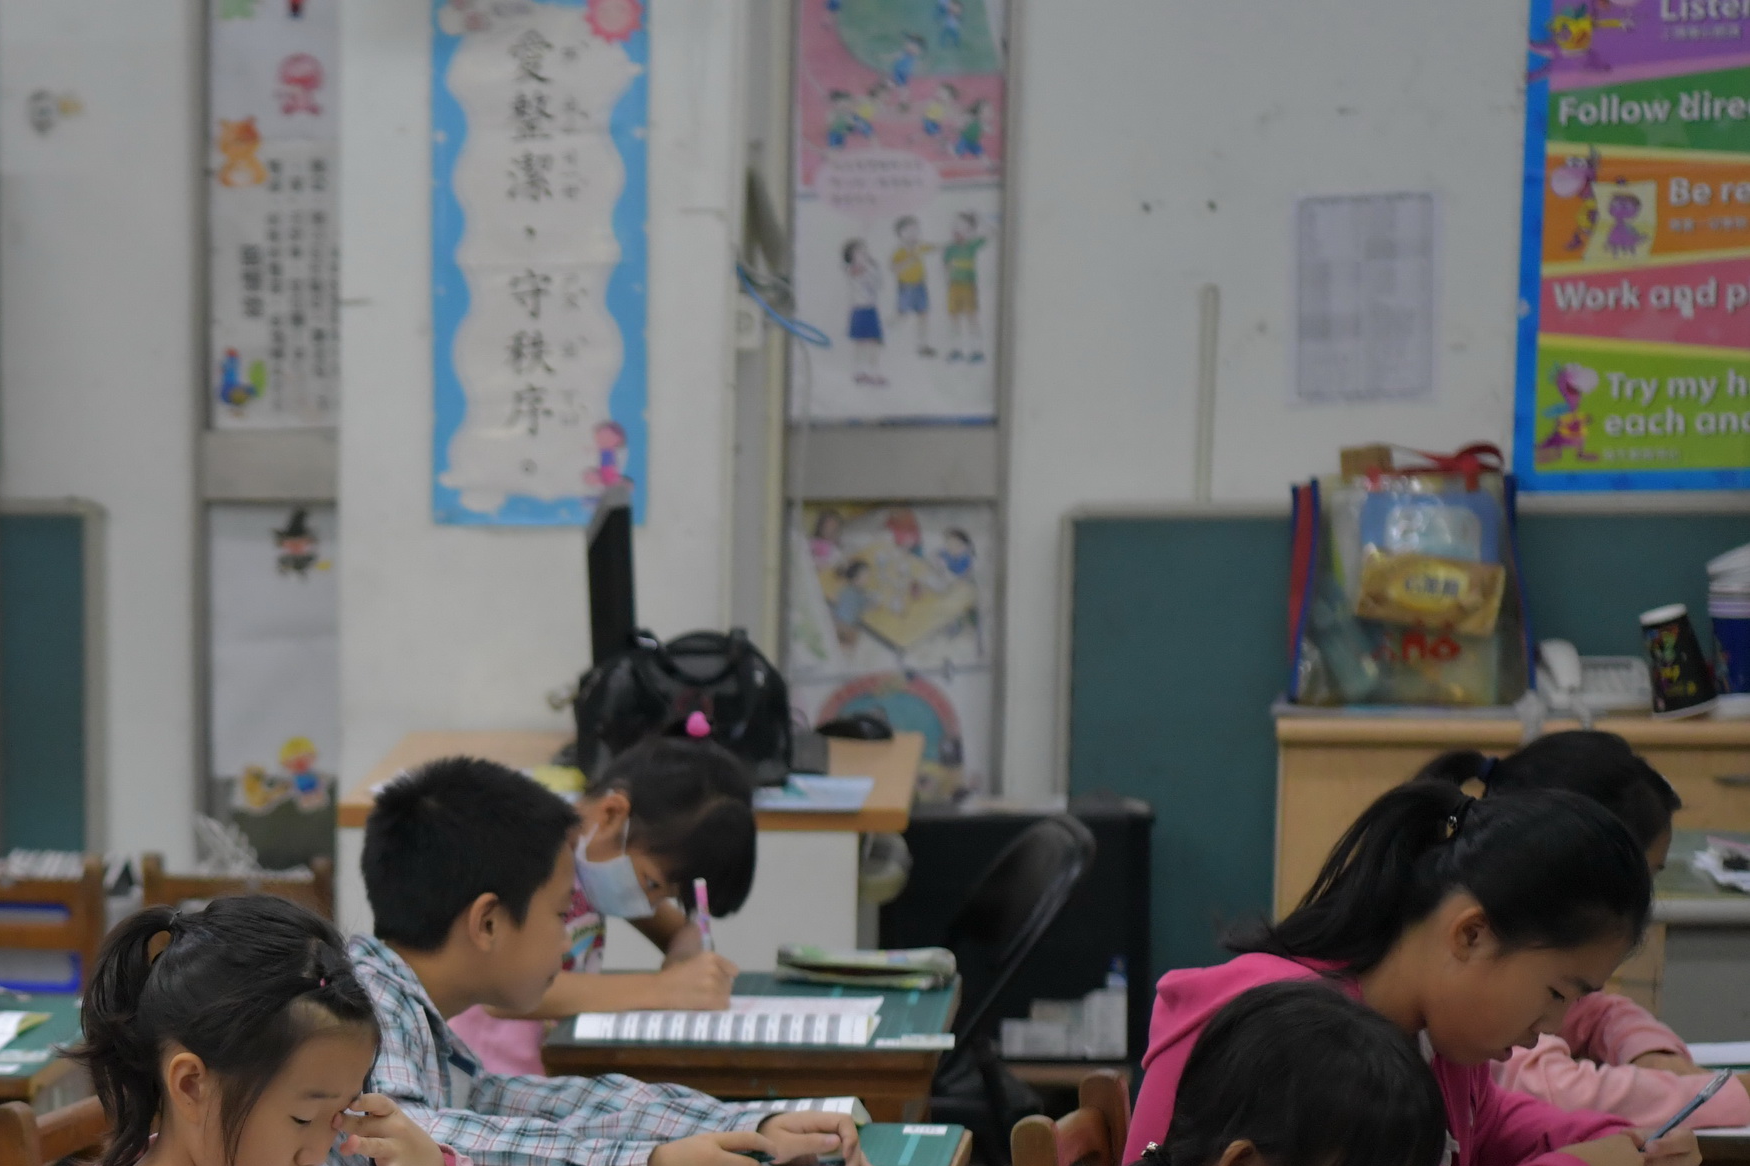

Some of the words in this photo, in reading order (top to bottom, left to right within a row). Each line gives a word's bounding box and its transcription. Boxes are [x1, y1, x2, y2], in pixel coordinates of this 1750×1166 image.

[1558, 93, 1671, 127] Follow
[1679, 90, 1750, 121] dire
[1669, 176, 1712, 207] Be
[1553, 277, 1641, 311] Work
[1606, 371, 1658, 407] Try
[1667, 375, 1718, 406] my
[1604, 406, 1686, 437] each
